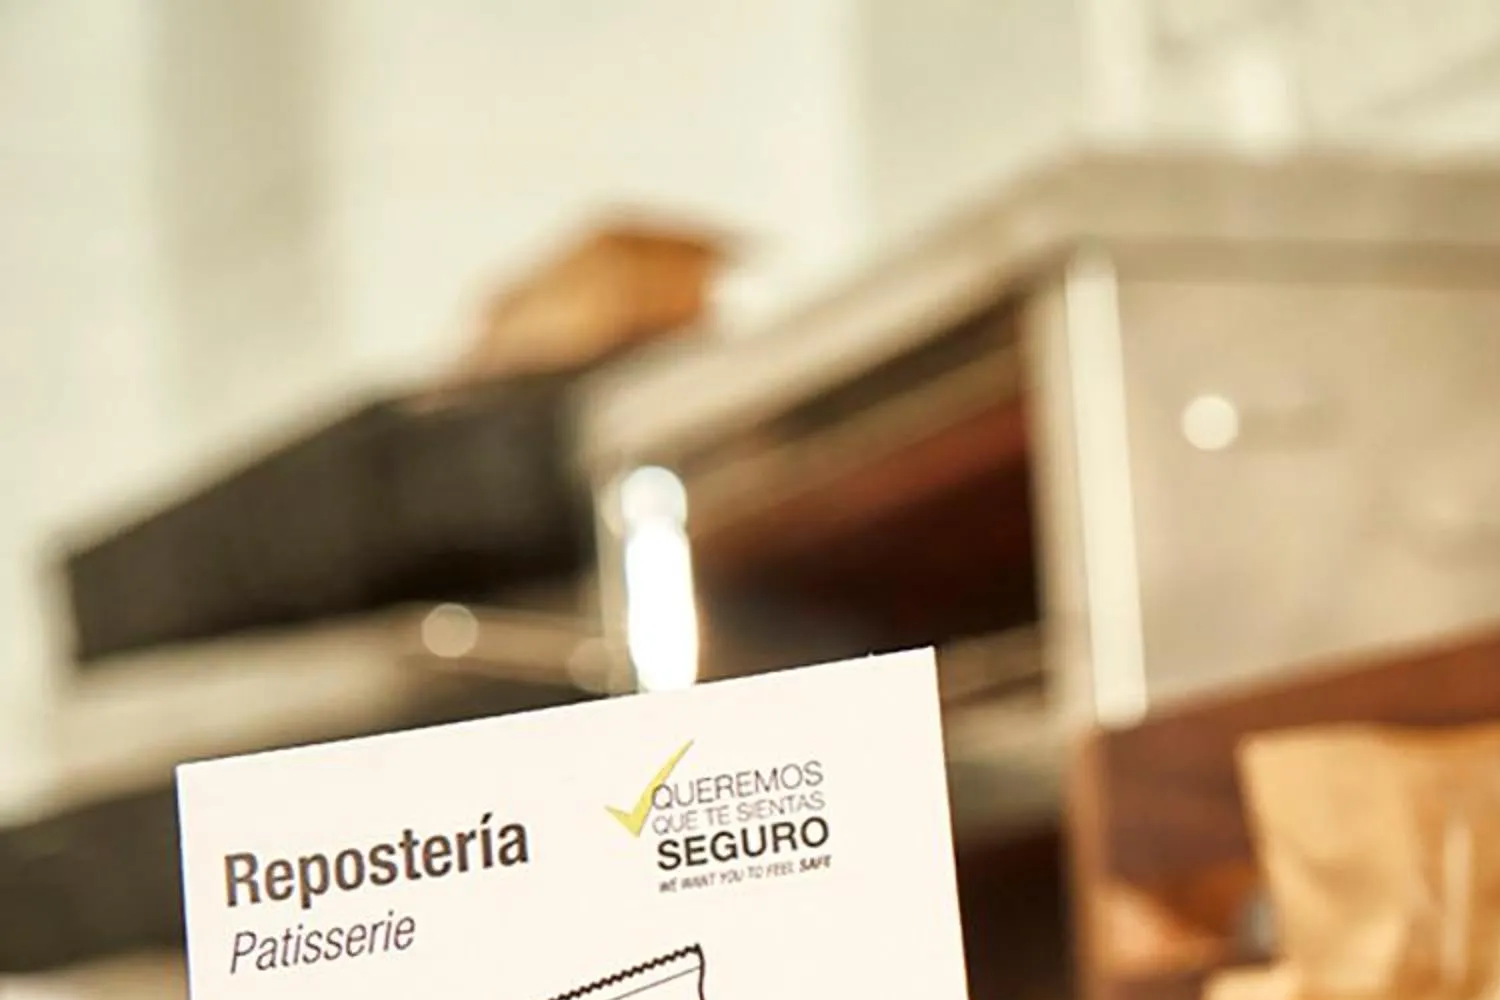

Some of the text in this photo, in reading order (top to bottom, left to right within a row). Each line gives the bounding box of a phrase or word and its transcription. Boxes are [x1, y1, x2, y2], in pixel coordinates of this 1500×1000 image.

[651, 760, 824, 811] QUEREMOS
[652, 790, 826, 836] QUE TE SIENTAS
[224, 811, 529, 910] Repostería
[656, 815, 829, 871] SEGURO
[719, 867, 745, 885] YOU
[748, 864, 764, 880] TO
[799, 854, 832, 874] SAFE
[230, 910, 416, 975] Patisserie
